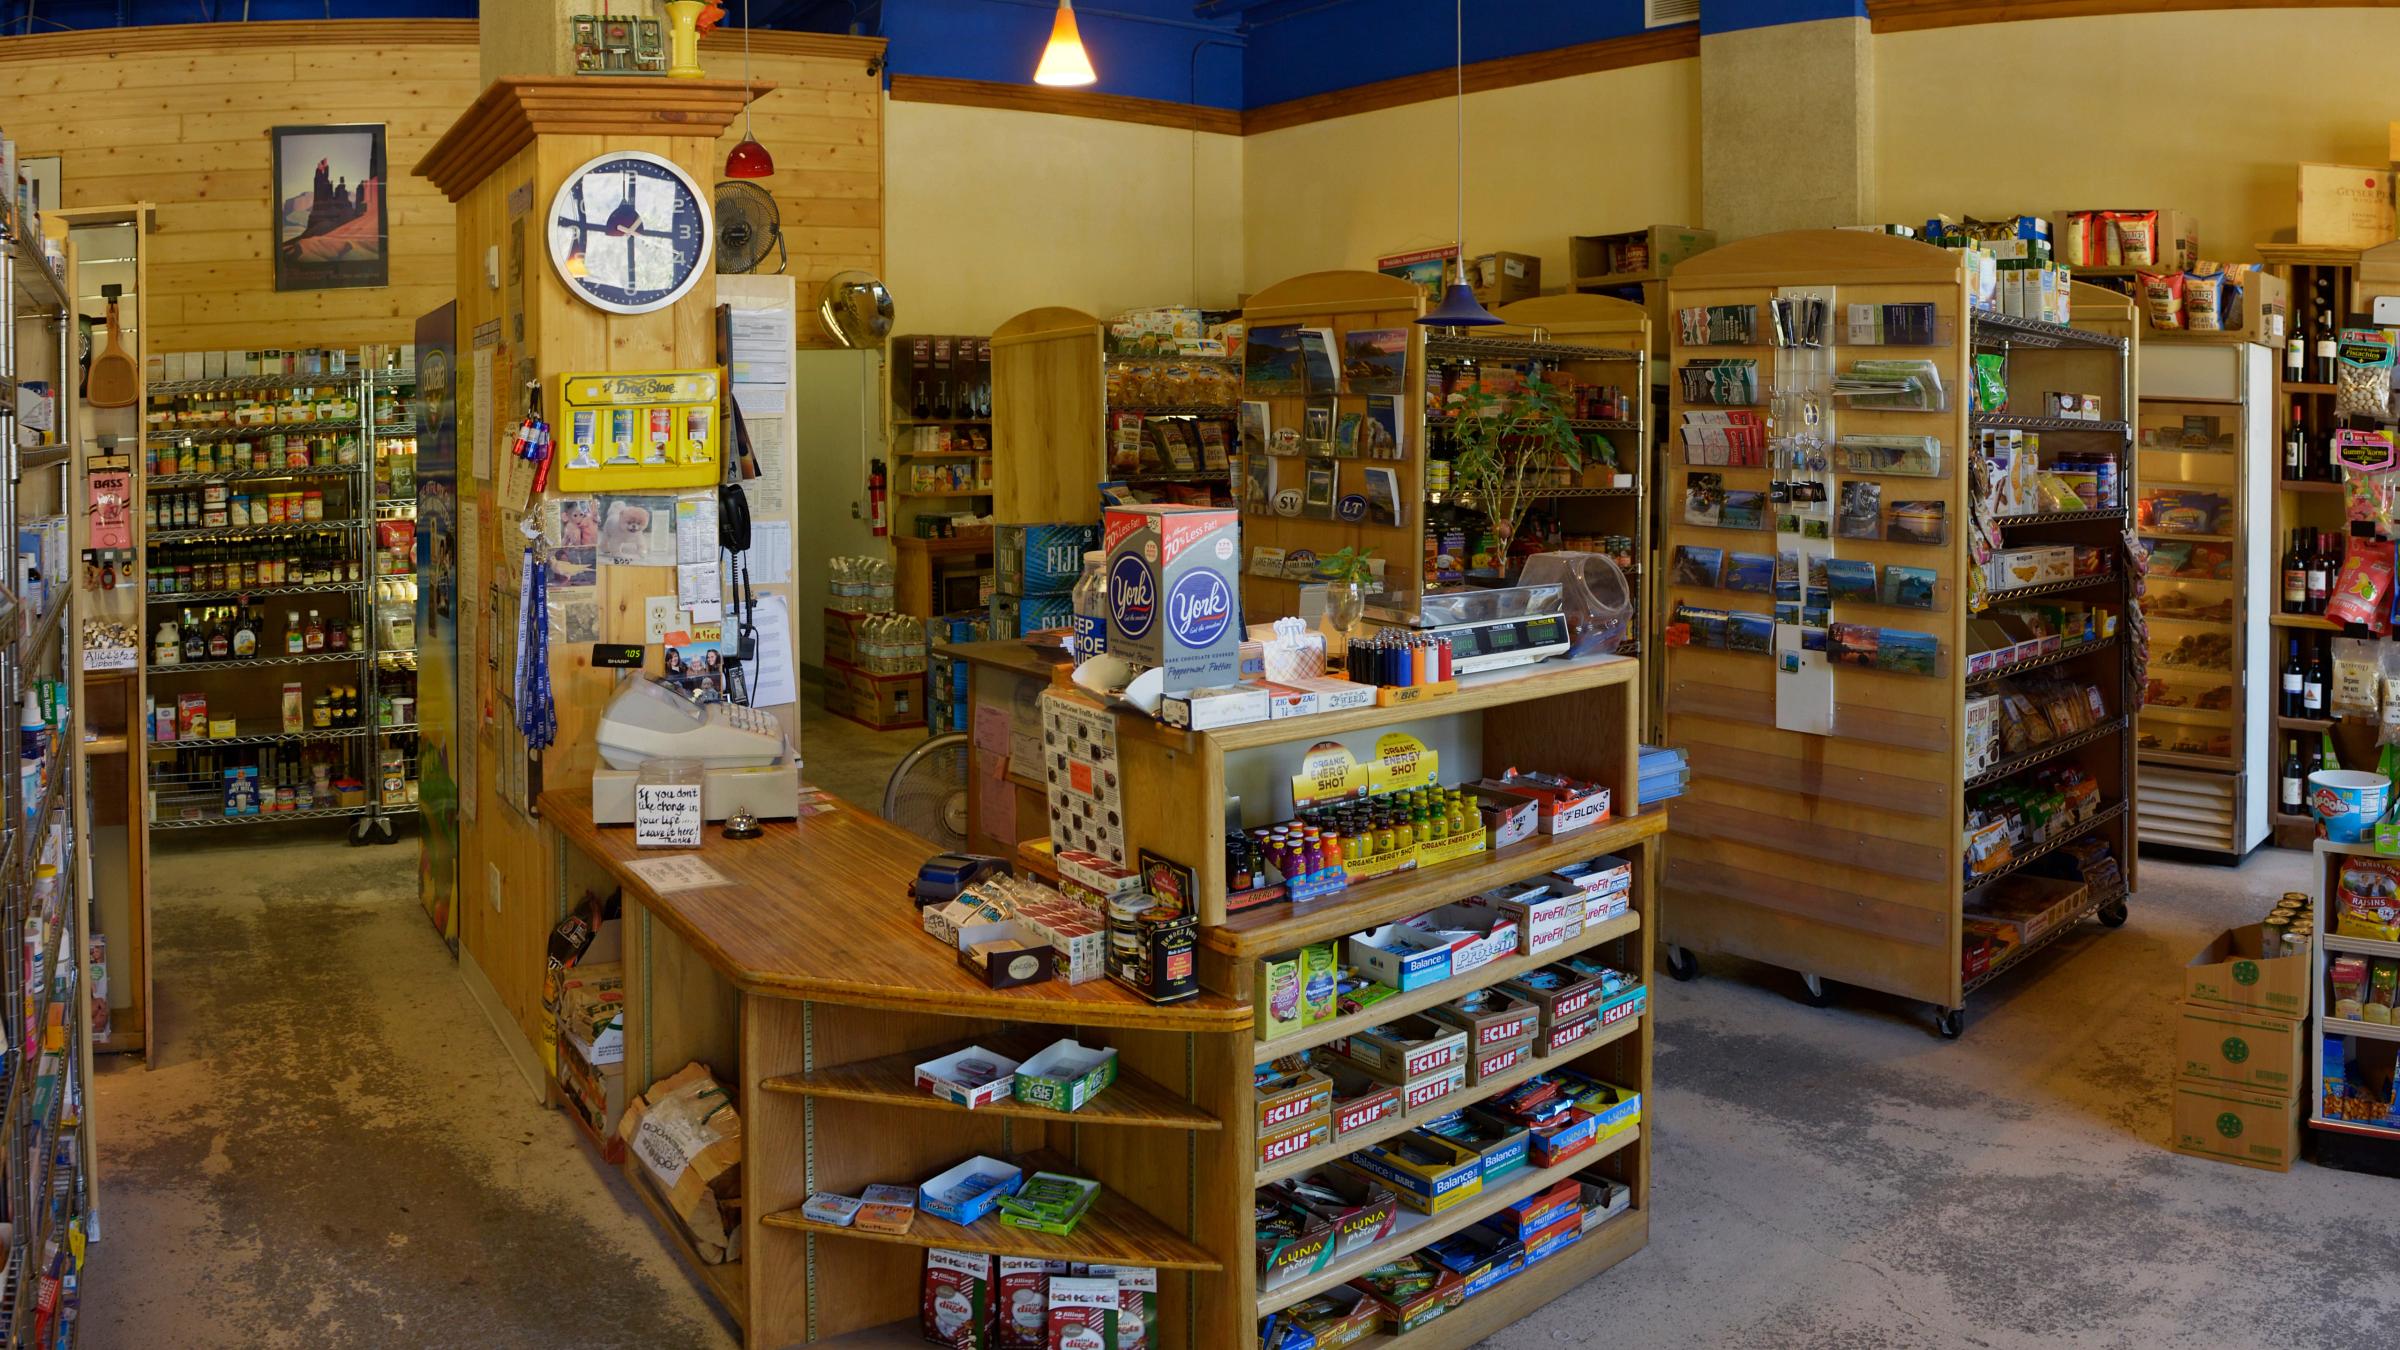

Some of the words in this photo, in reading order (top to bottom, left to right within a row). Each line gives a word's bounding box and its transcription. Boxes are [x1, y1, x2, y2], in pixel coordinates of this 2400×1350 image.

[679, 224, 692, 240] 3
[93, 478, 124, 490] BASS
[1279, 495, 1299, 510] SV
[1342, 501, 1363, 516] LT
[1165, 537, 1185, 561] 70%
[1185, 526, 1203, 542] Less
[1202, 519, 1218, 533] Fat!
[1047, 545, 1079, 574] FIJI
[1115, 571, 1153, 621] York
[1176, 581, 1229, 635] York
[1167, 665, 1206, 680] Peppermint
[43, 682, 51, 698] Gas
[1400, 690, 1419, 700] BIC
[43, 699, 52, 720] Relief
[1275, 697, 1287, 706] ZIG
[1301, 694, 1316, 702] ZAG
[1383, 743, 1417, 756] ORGANIC
[1313, 756, 1346, 769] ORGANIC
[1383, 752, 1422, 767] ENERGY
[1310, 765, 1350, 781] ENERGY
[1391, 762, 1417, 777] SHOT
[1317, 776, 1346, 791] SHOT
[638, 787, 650, 808] If
[655, 791, 675, 801] you
[656, 801, 686, 816] change
[1574, 801, 1606, 819] BLOKS
[639, 817, 660, 828] your
[1512, 815, 1527, 826] SHOT
[1421, 838, 1448, 851] ORGANIC
[1447, 833, 1471, 846] ENERGY
[1471, 829, 1485, 840] SHOT
[1346, 857, 1375, 869] ORGANIC
[1375, 851, 1400, 863] ENERGY
[1400, 846, 1416, 858] SHOT
[1247, 889, 1276, 903] ENERGY
[2352, 897, 2386, 908] RAISINS
[1532, 905, 1565, 925] PureFit
[1585, 903, 1609, 921] ureFit
[1532, 928, 1564, 948] PureFit
[1456, 936, 1516, 967] Protein
[1410, 955, 1442, 972] Balance
[1563, 993, 1588, 1013] CLIF
[1609, 1000, 1634, 1021] CLIF
[1489, 1021, 1520, 1041] CLIF
[1559, 1022, 1584, 1044] CLIF
[1418, 1048, 1450, 1072] CLIF
[1488, 1050, 1515, 1074] CLIF
[1416, 1080, 1448, 1103] CLIF
[1274, 1098, 1310, 1122] CLIF
[1348, 1104, 1380, 1128] CLIF
[1607, 1105, 1633, 1122] LUNA
[1273, 1133, 1309, 1158] CLIF
[1560, 1127, 1588, 1146] LUNA
[1485, 1149, 1516, 1168] Balance
[1352, 1152, 1389, 1180] Balance
[1394, 1173, 1415, 1190] BARE
[1436, 1172, 1474, 1194] Balance
[1462, 1177, 1478, 1189] BARE
[977, 1184, 1009, 1214] Trident
[1343, 1210, 1386, 1235] LUNA
[1346, 1223, 1381, 1246] protein
[1278, 1241, 1323, 1267] LUNA
[931, 1271, 939, 1280] 2
[937, 1272, 958, 1282] fillings
[1282, 1255, 1318, 1279] protein
[1006, 1278, 1014, 1287] 2
[1013, 1278, 1035, 1286] fillings
[1054, 1311, 1062, 1320] 2
[1062, 1311, 1086, 1319] fillings
[1066, 1339, 1099, 1350] duets
